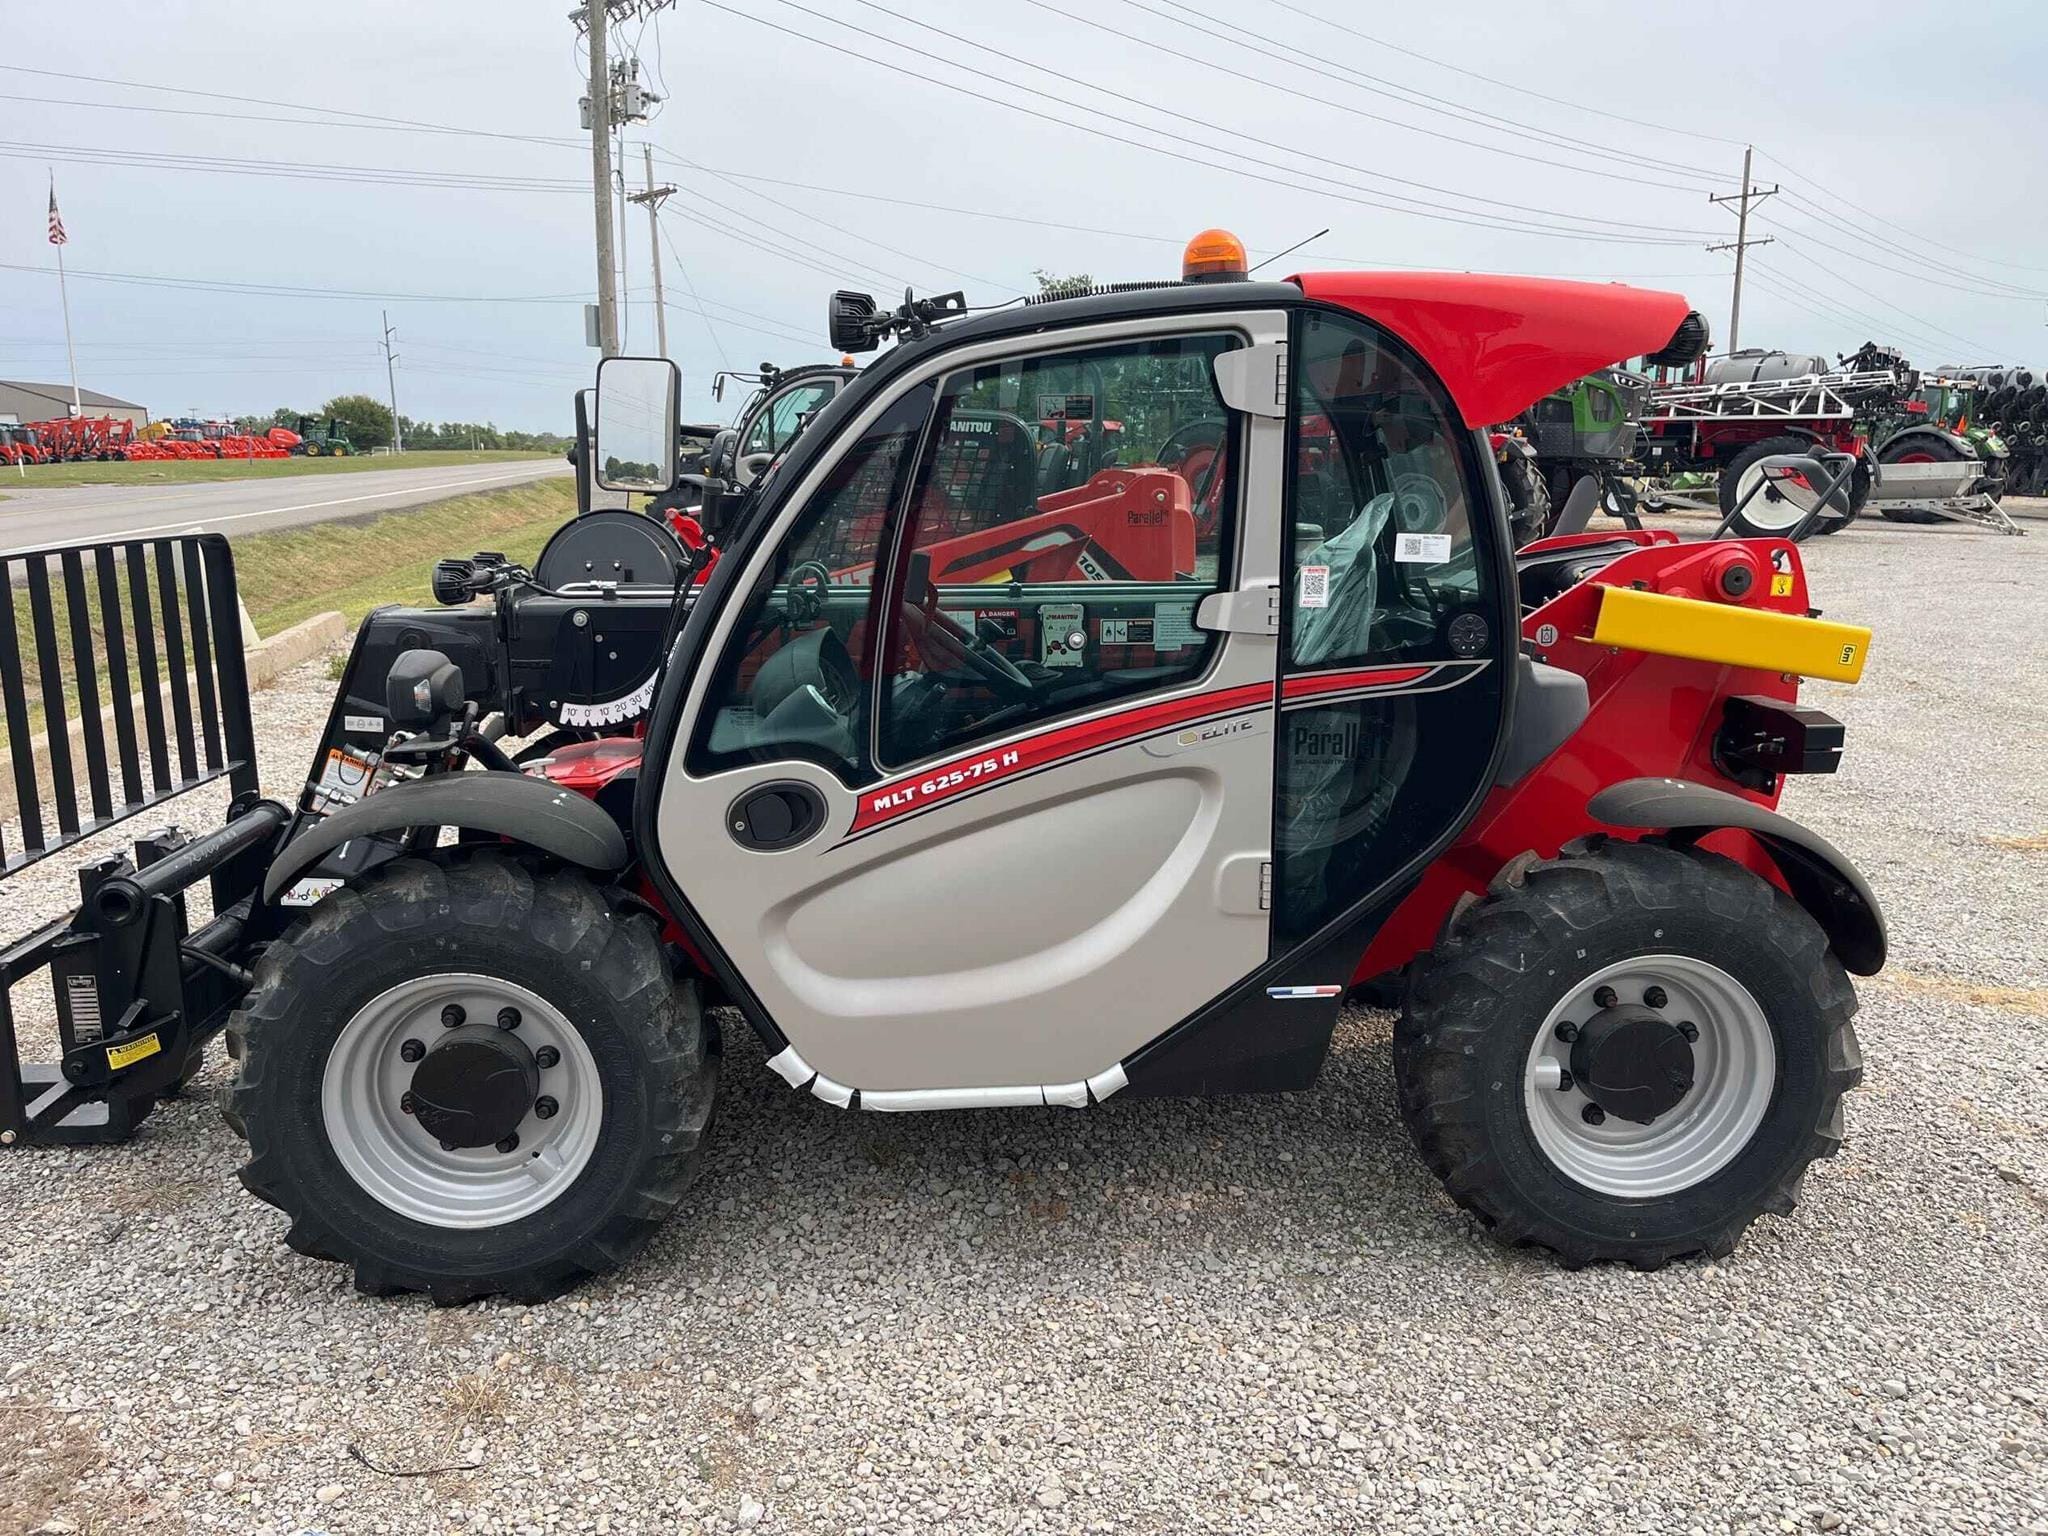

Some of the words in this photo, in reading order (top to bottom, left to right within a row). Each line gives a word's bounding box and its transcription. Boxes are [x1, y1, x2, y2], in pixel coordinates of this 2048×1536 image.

[1841, 646, 1854, 663] 6m
[1201, 718, 1253, 741] ELITE
[873, 786, 916, 812] MLT
[920, 758, 998, 795] 625-75
[1002, 750, 1019, 767] H
[119, 1036, 155, 1054] WARNING
